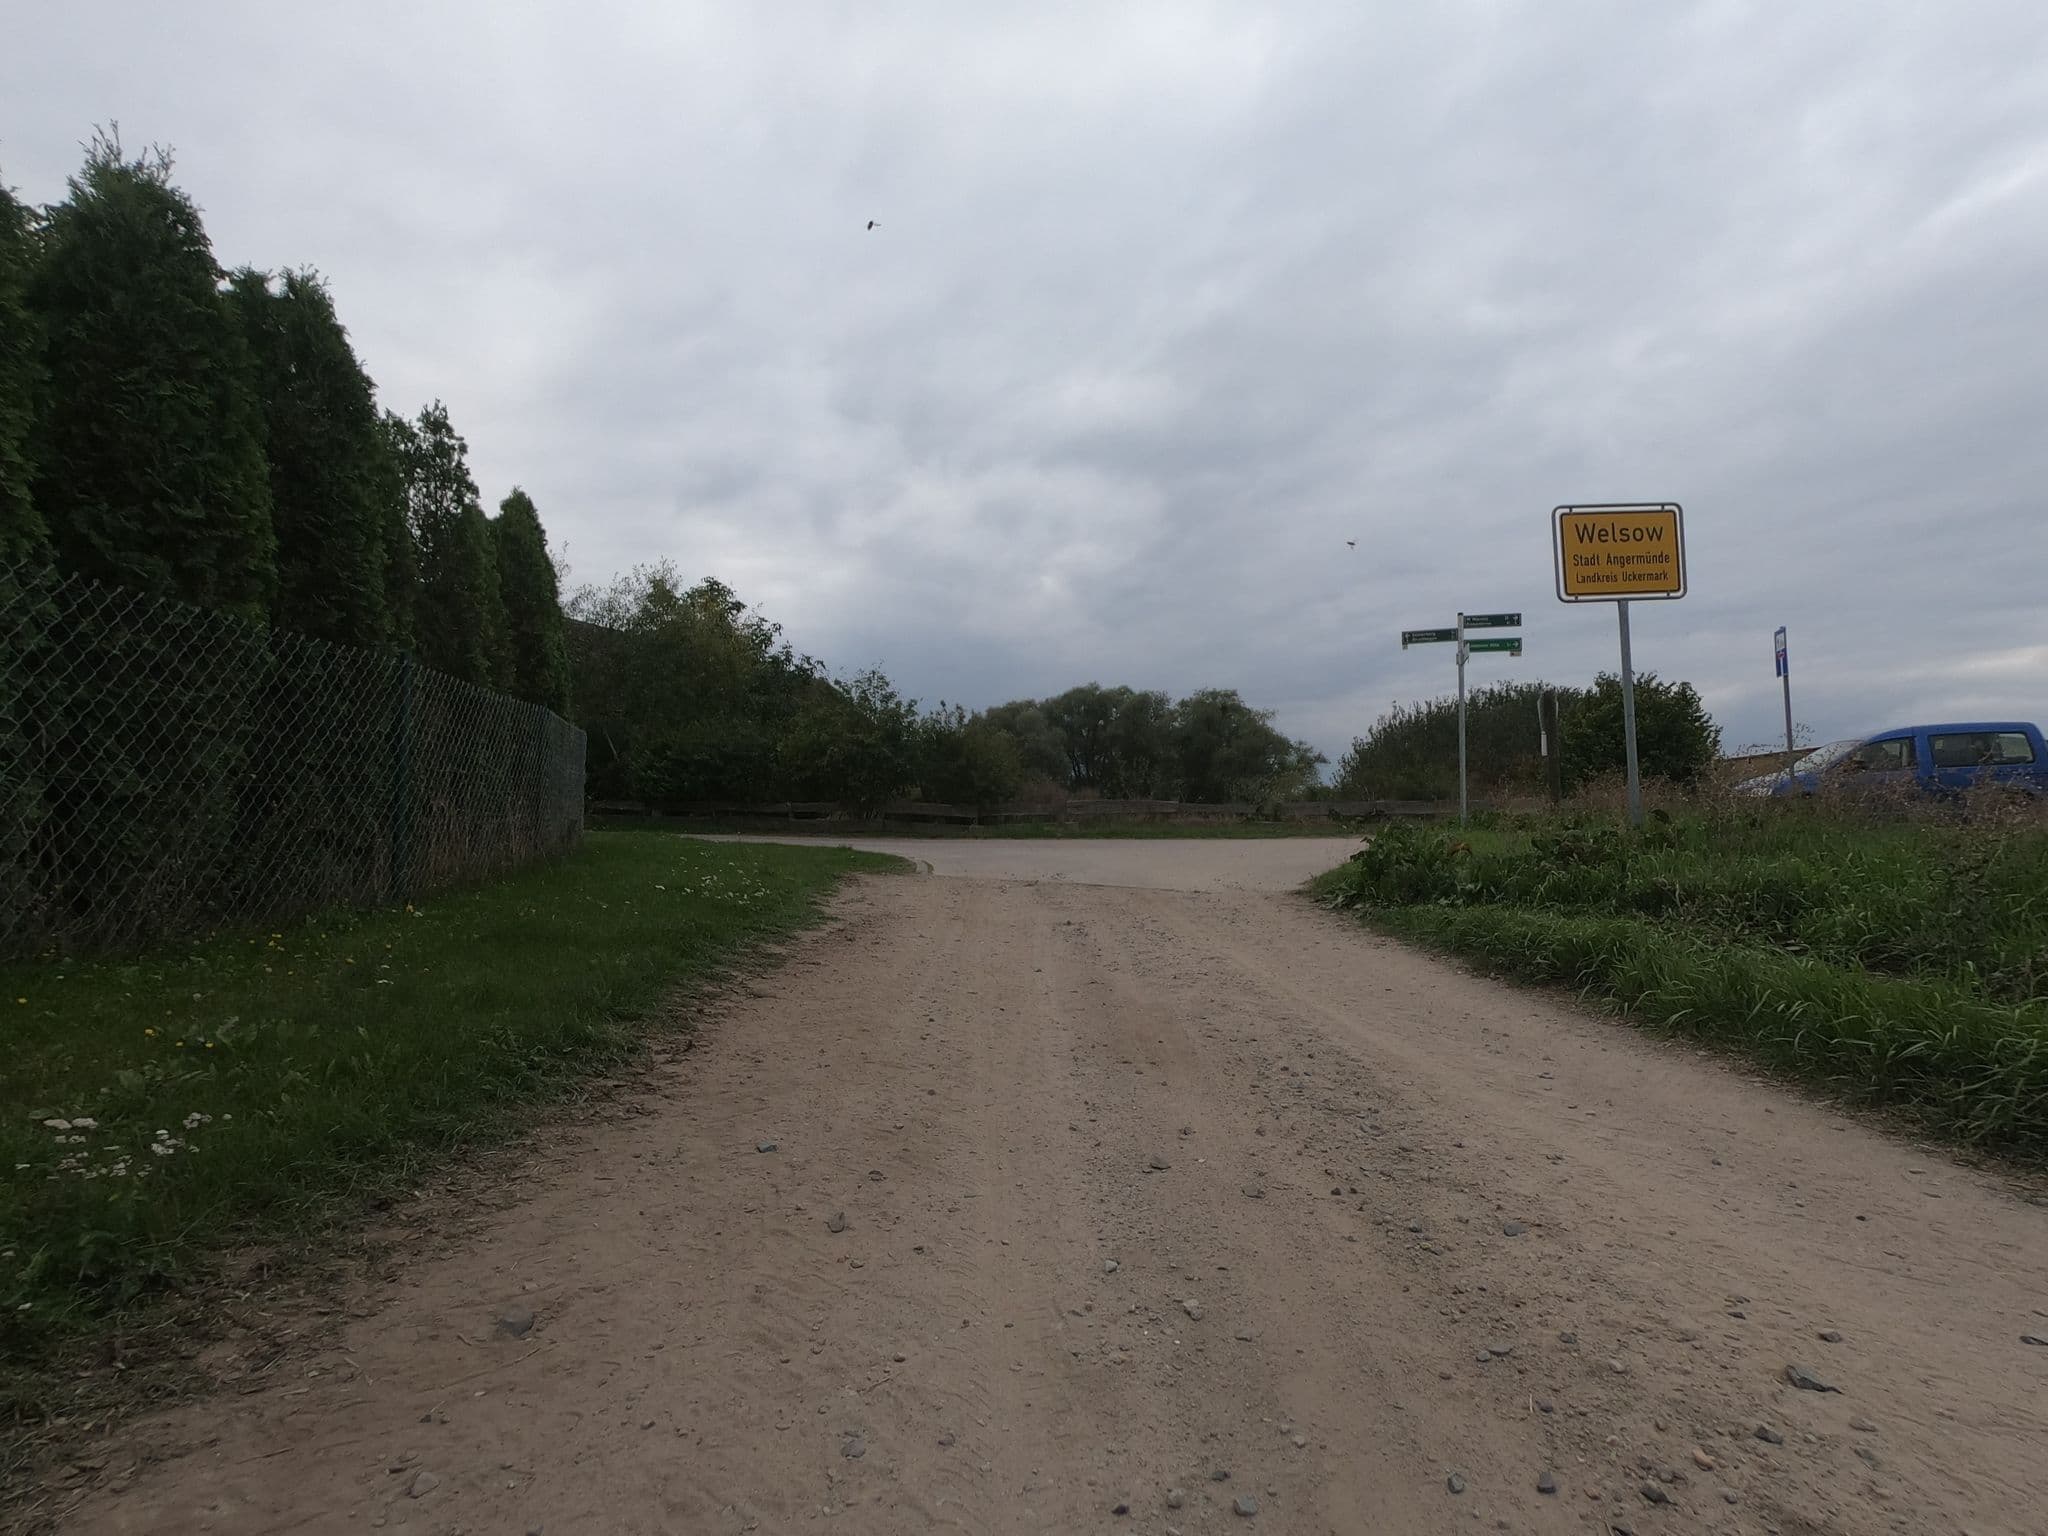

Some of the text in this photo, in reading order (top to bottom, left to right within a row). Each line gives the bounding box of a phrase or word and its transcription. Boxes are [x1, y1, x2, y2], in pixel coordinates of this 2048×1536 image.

[1575, 522, 1663, 544] Welsow
[1573, 551, 1670, 568] Stadt Angermünde
[1576, 570, 1668, 583] Landkreis Uckermark
